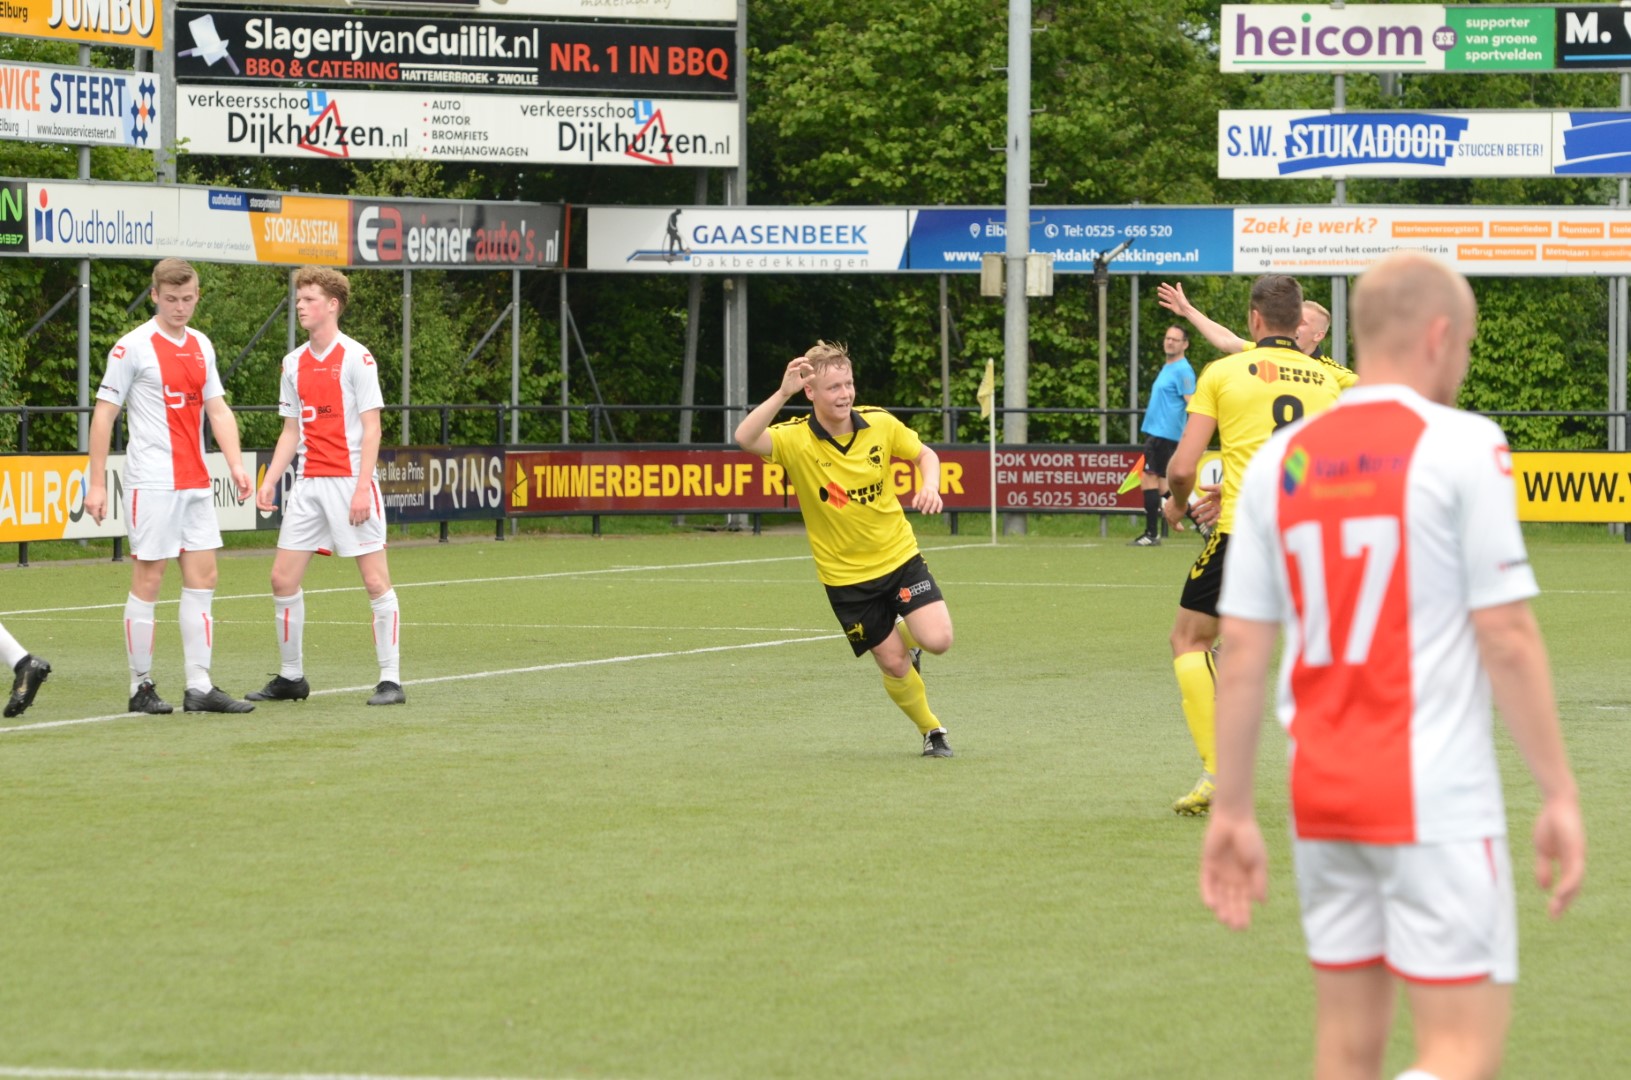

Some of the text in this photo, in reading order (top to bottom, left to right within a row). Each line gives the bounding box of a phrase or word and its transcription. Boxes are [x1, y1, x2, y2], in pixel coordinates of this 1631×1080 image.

[48, 0, 155, 38] JUMBO
[1466, 17, 1530, 30] supporter
[245, 18, 539, 60] SlagerijvanGuilik.nl
[1235, 13, 1422, 56] heicom
[1466, 35, 1537, 47] van groene
[550, 43, 728, 80] NR. 1 IN BBQ
[1465, 49, 1542, 63] sportvelden
[246, 58, 398, 80] BBQ & CATERING
[497, 73, 538, 85] ZWOLLE
[50, 72, 126, 117] STEERT
[432, 100, 461, 111] AUTO
[432, 115, 471, 125] MOTOR
[36, 122, 117, 139] www.bouwservicesteert.nl
[432, 130, 489, 141] BROMFIETS
[1227, 124, 1446, 158] S.W. STUKADOOR
[1458, 143, 1543, 157] STUCCEN BETER!
[432, 145, 529, 157] AANHANGWAGEN
[58, 208, 153, 245] Oudholland
[264, 216, 338, 245] STORASYSTEM
[693, 225, 867, 244] GAASENBEEK
[1063, 225, 1083, 237] Tel:
[1085, 225, 1115, 237] 0525
[1124, 225, 1147, 237] 656
[1150, 225, 1173, 237] 520
[1242, 217, 1378, 238] Zoek je werk?
[407, 214, 471, 262] eisner
[1262, 245, 1273, 255] bij
[1293, 245, 1316, 255] langs
[1320, 245, 1327, 253] of
[1329, 245, 1343, 253] vul
[1345, 245, 1360, 253] het
[1440, 244, 1448, 253] in
[693, 255, 868, 271] Dakbedekkingen
[1260, 259, 1271, 267] op
[1272, 394, 1304, 434] 8
[995, 453, 1135, 467] OOK VOOR TEGEL-
[388, 461, 400, 481] like
[401, 467, 406, 481] a
[408, 461, 424, 480] Prins
[997, 471, 1127, 484] EN METSELWERK
[429, 456, 502, 511] PRINS
[534, 464, 753, 498] TIMMERBEDRIJF
[1007, 491, 1118, 506] 06 5025 3065
[1283, 515, 1401, 667] 17
